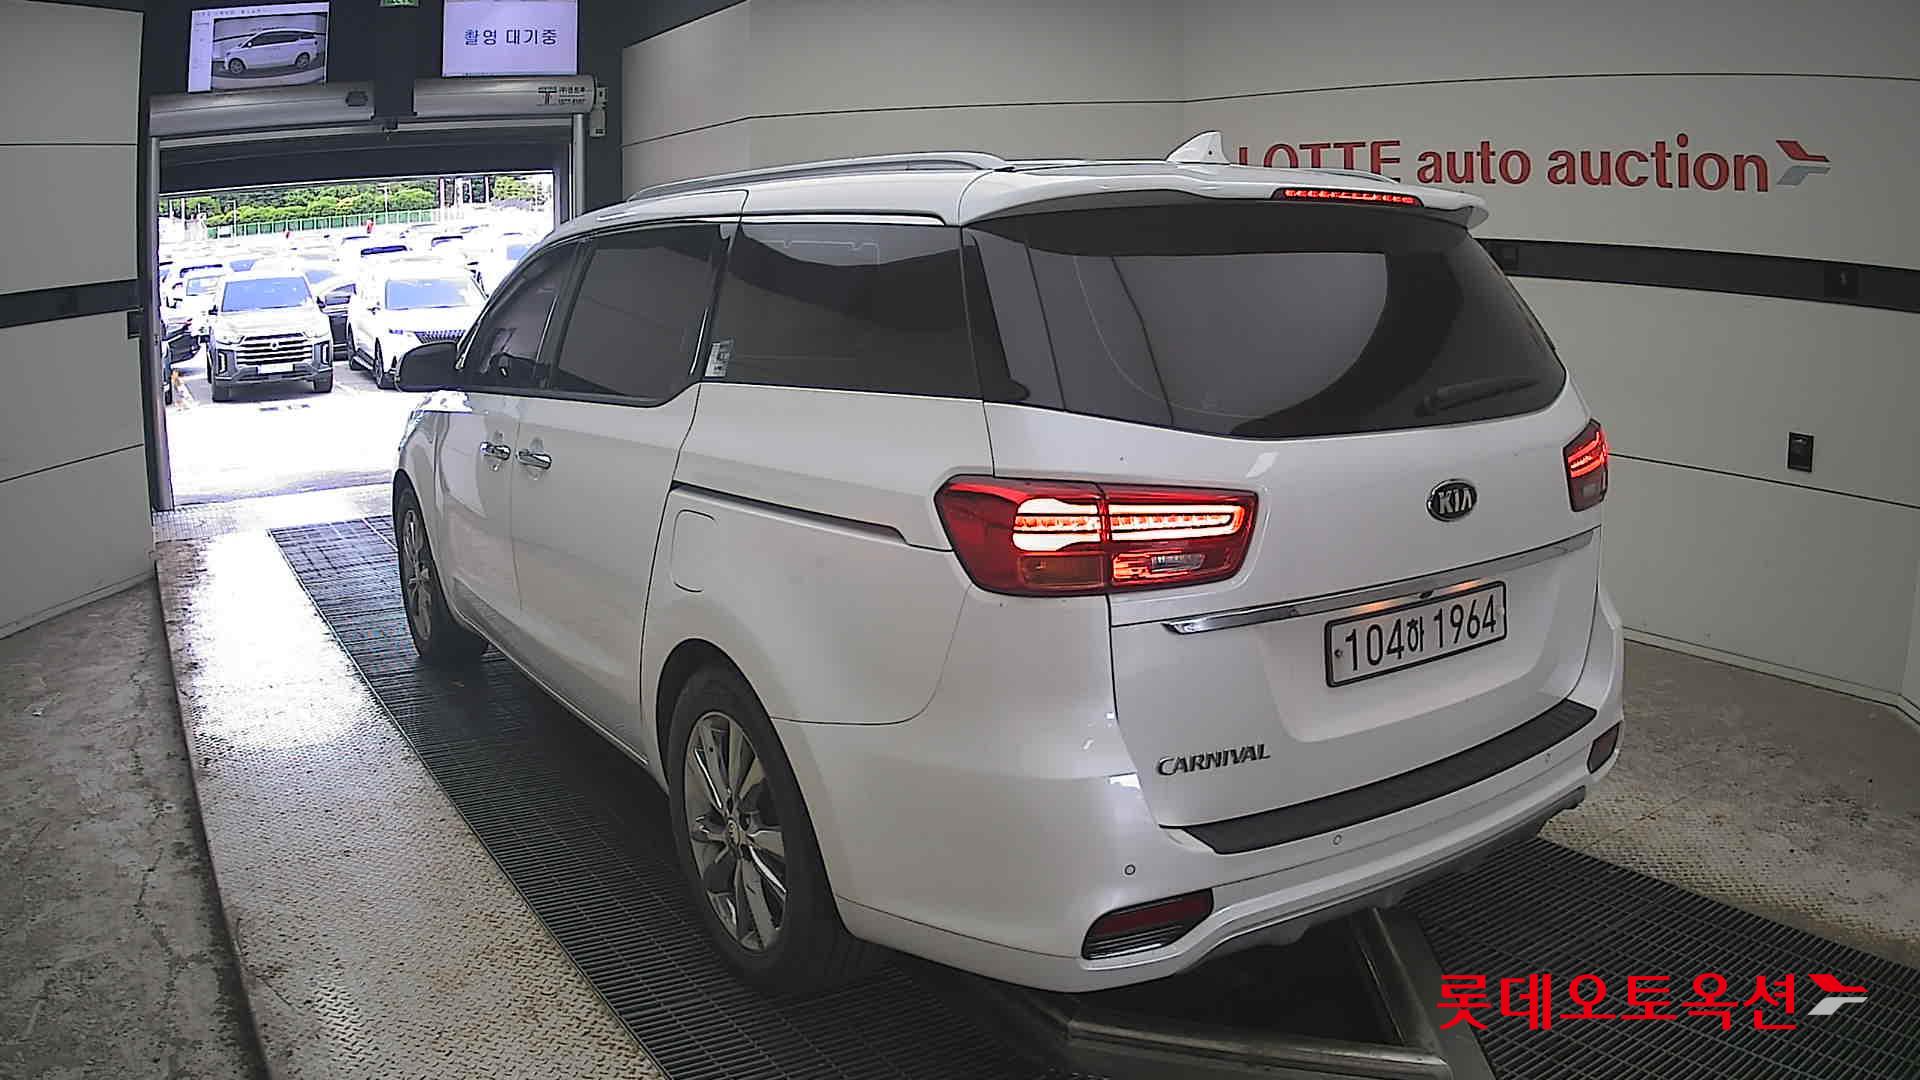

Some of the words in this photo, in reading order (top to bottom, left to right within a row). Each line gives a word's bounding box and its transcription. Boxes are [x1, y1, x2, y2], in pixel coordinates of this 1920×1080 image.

[464, 28, 497, 46] 촬영
[505, 28, 557, 46] 대기중
[1416, 140, 1531, 185] auto
[1547, 133, 1769, 192] auction
[1438, 487, 1473, 514] KIA
[1345, 615, 1424, 671] 104하
[1433, 594, 1497, 649] 1964
[1158, 743, 1271, 776] CARNIVAL
